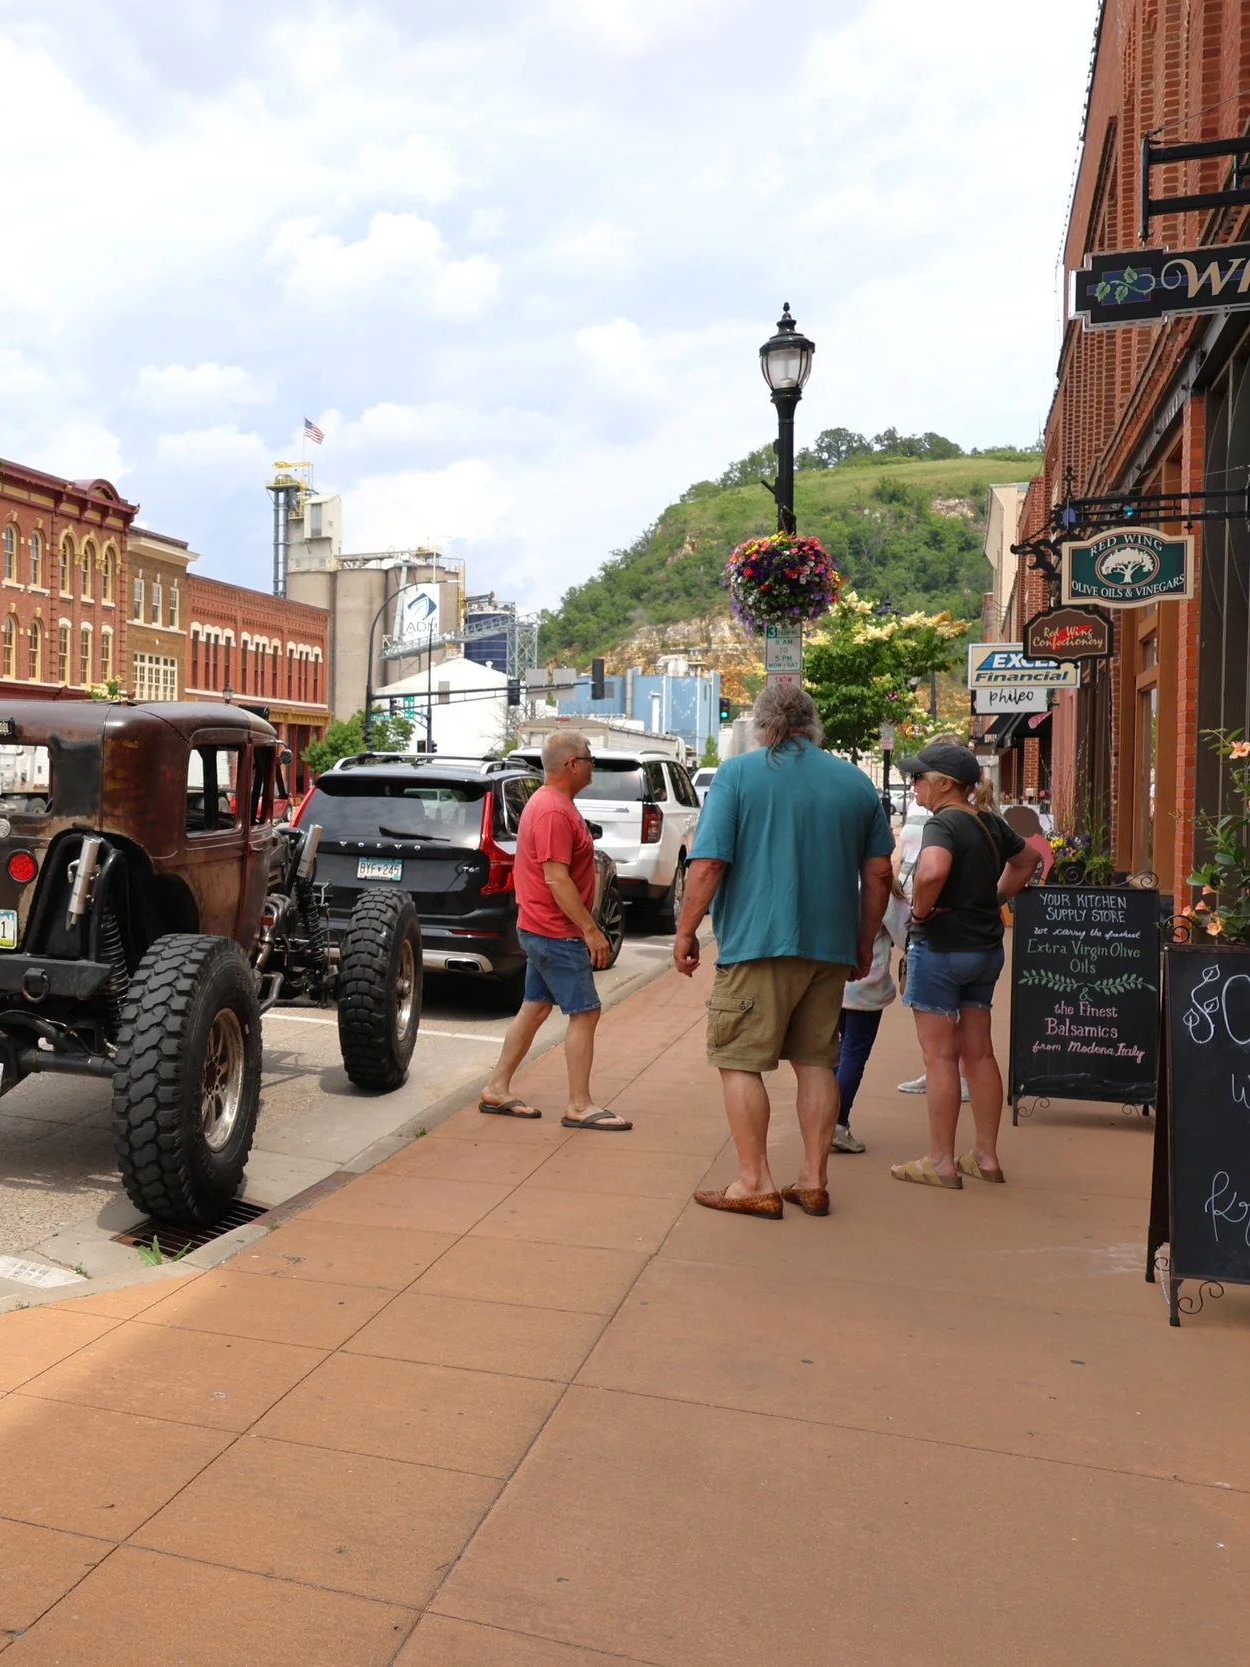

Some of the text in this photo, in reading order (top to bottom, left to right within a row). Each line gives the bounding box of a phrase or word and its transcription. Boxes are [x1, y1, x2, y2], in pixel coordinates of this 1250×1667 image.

[1090, 534, 1163, 557] RED WING
[1071, 573, 1185, 598] OLIVE OILS & VINEGARS
[406, 621, 438, 632] ADM
[768, 624, 776, 638] 3
[1044, 626, 1093, 640] Red Wing
[1033, 636, 1103, 650] Confectionery
[975, 671, 1069, 682] Financial
[989, 688, 1034, 706] phileo
[339, 841, 421, 850] VOLVO
[1039, 893, 1127, 909] YOUR KITCHEN
[1045, 907, 1126, 923] SUPPLY STORE
[1052, 928, 1086, 940] carry
[1090, 927, 1102, 937] the
[1104, 930, 1141, 940] freshest
[1027, 938, 1141, 961] Extra Virgin Olive
[1070, 958, 1096, 974] Oils
[1079, 987, 1093, 1002] &
[1054, 1000, 1118, 1018] the Finest
[1044, 1017, 1118, 1038] Balsamics
[1032, 1040, 1145, 1064] from Modena Italy
